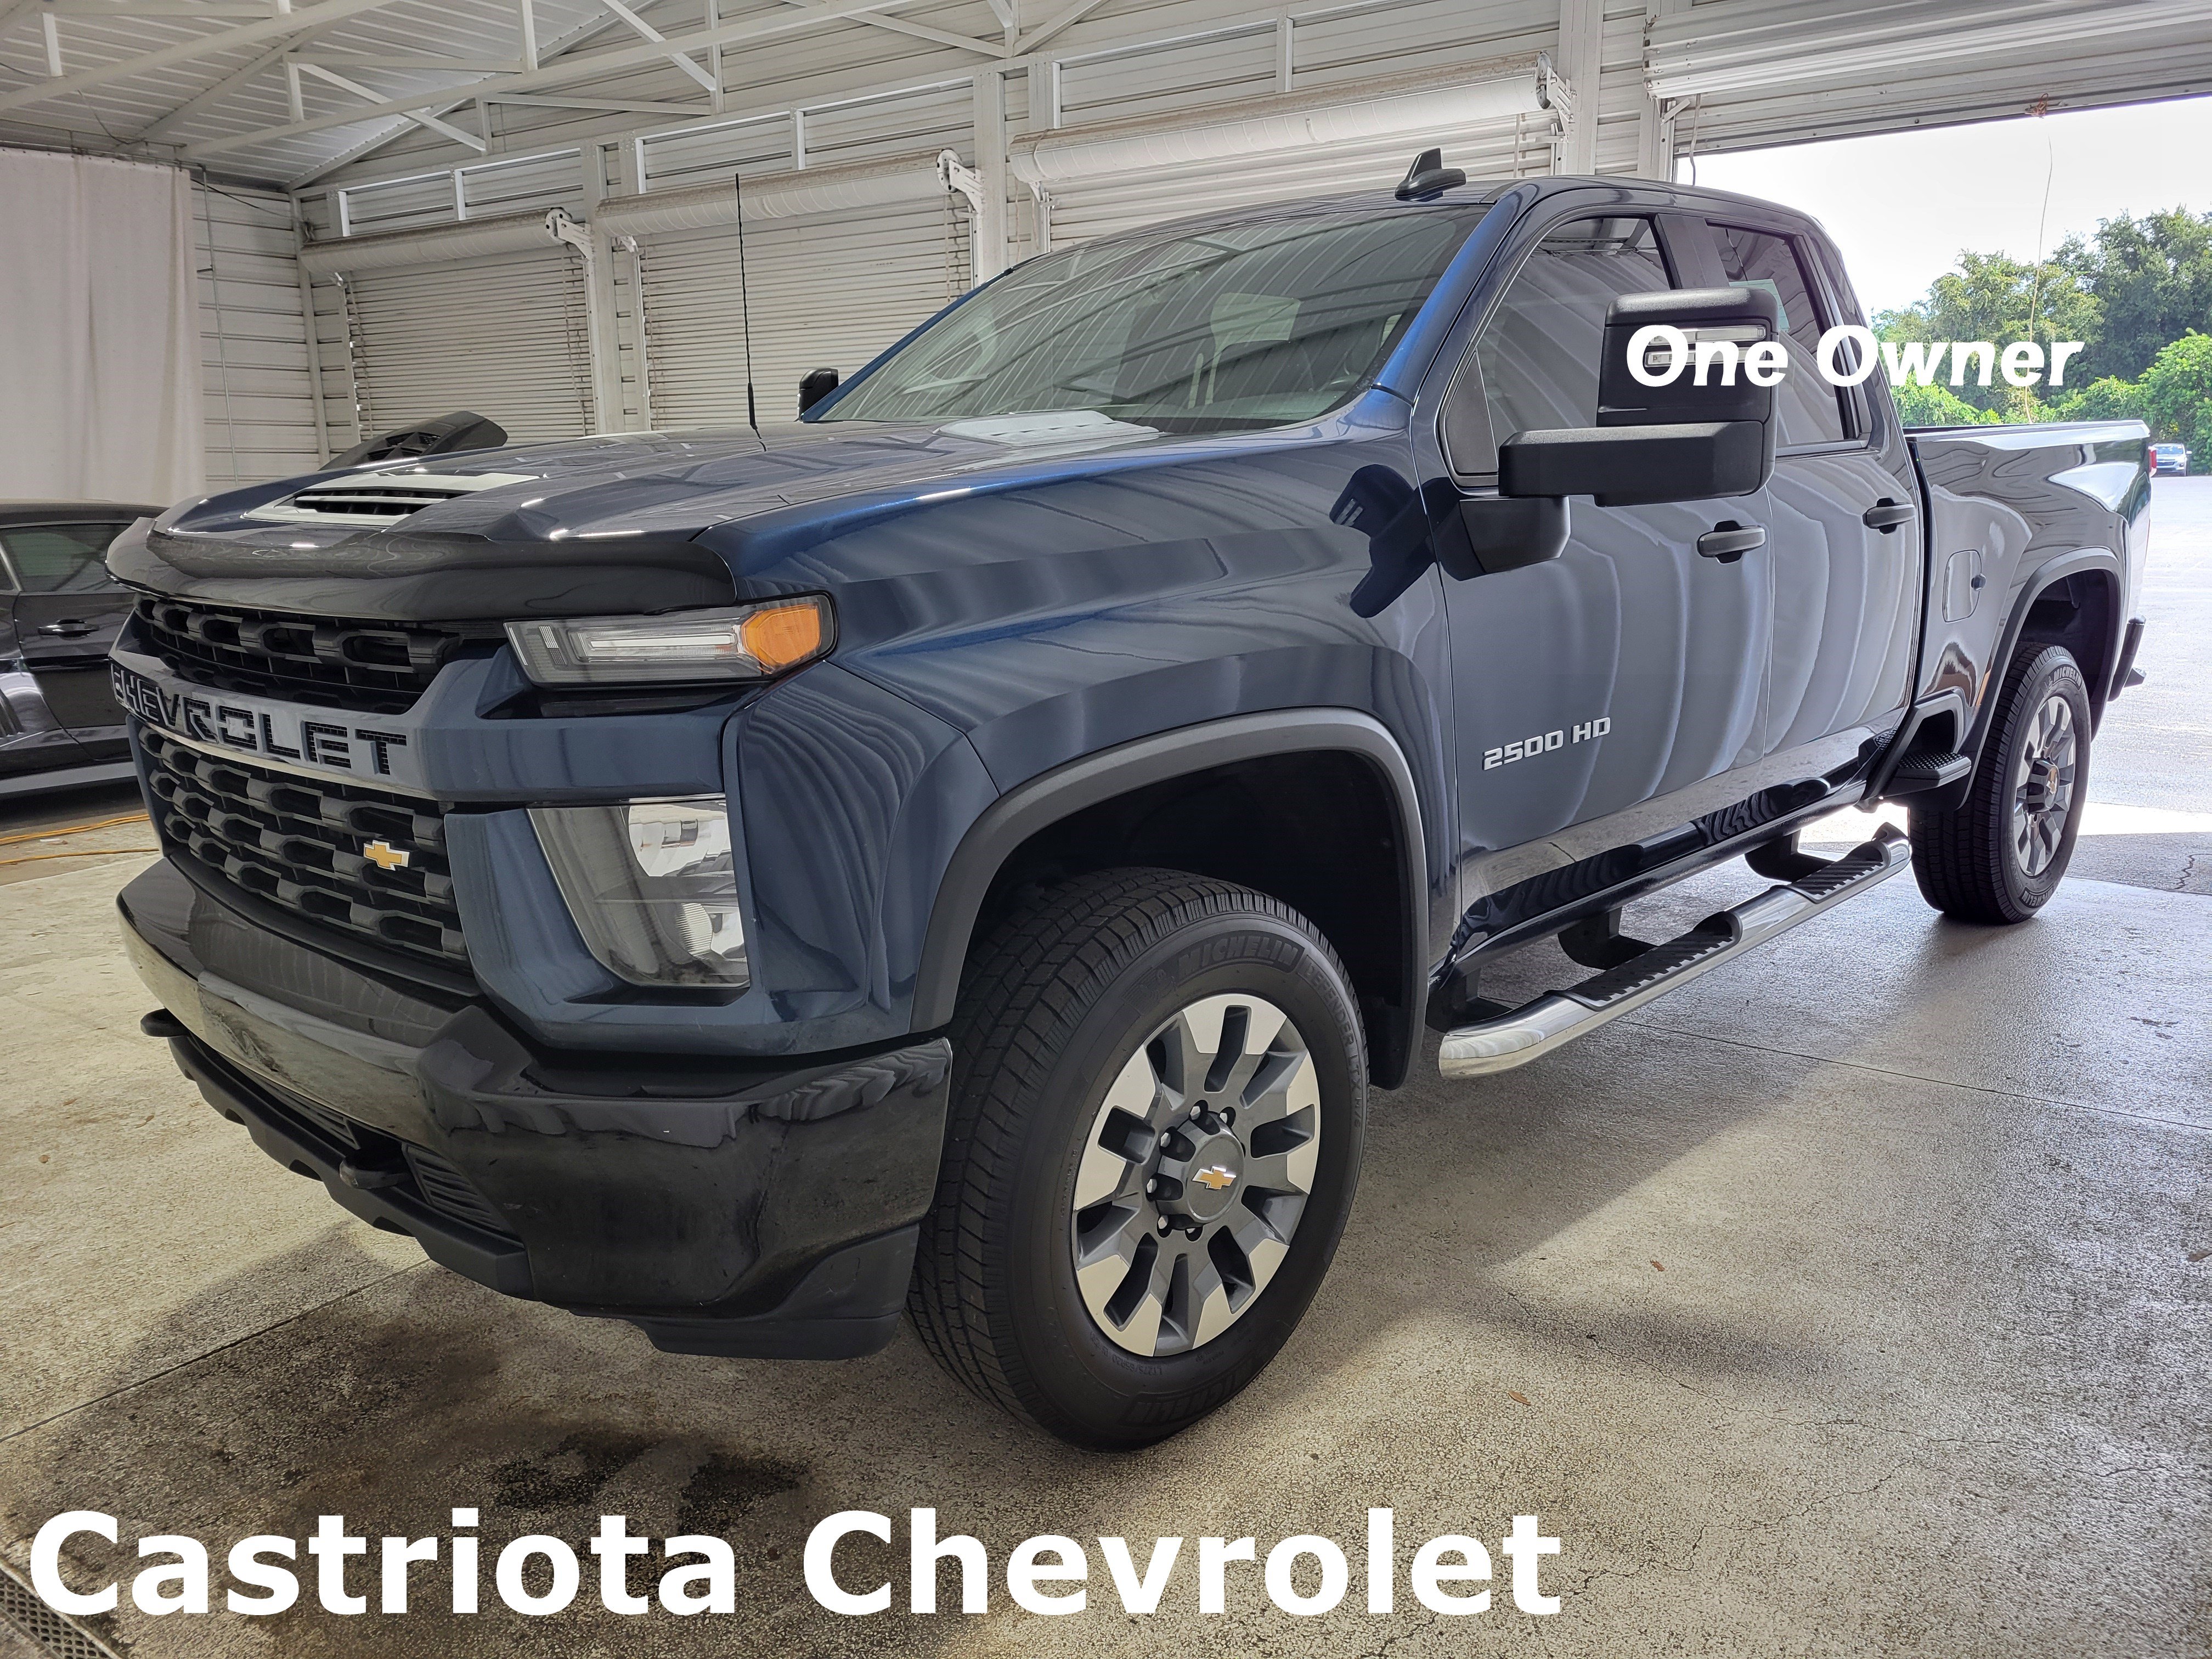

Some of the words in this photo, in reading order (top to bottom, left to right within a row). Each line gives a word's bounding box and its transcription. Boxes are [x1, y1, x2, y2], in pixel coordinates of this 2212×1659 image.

[2053, 666, 2082, 687] MICHELIN
[110, 662, 407, 775] CHEVROLET
[1483, 730, 1564, 771] 2500
[1571, 716, 1611, 744] HD
[1178, 935, 1299, 975] MICHELIN
[1303, 963, 1355, 1045] DEFENDER
[1348, 1054, 1362, 1092] LTX
